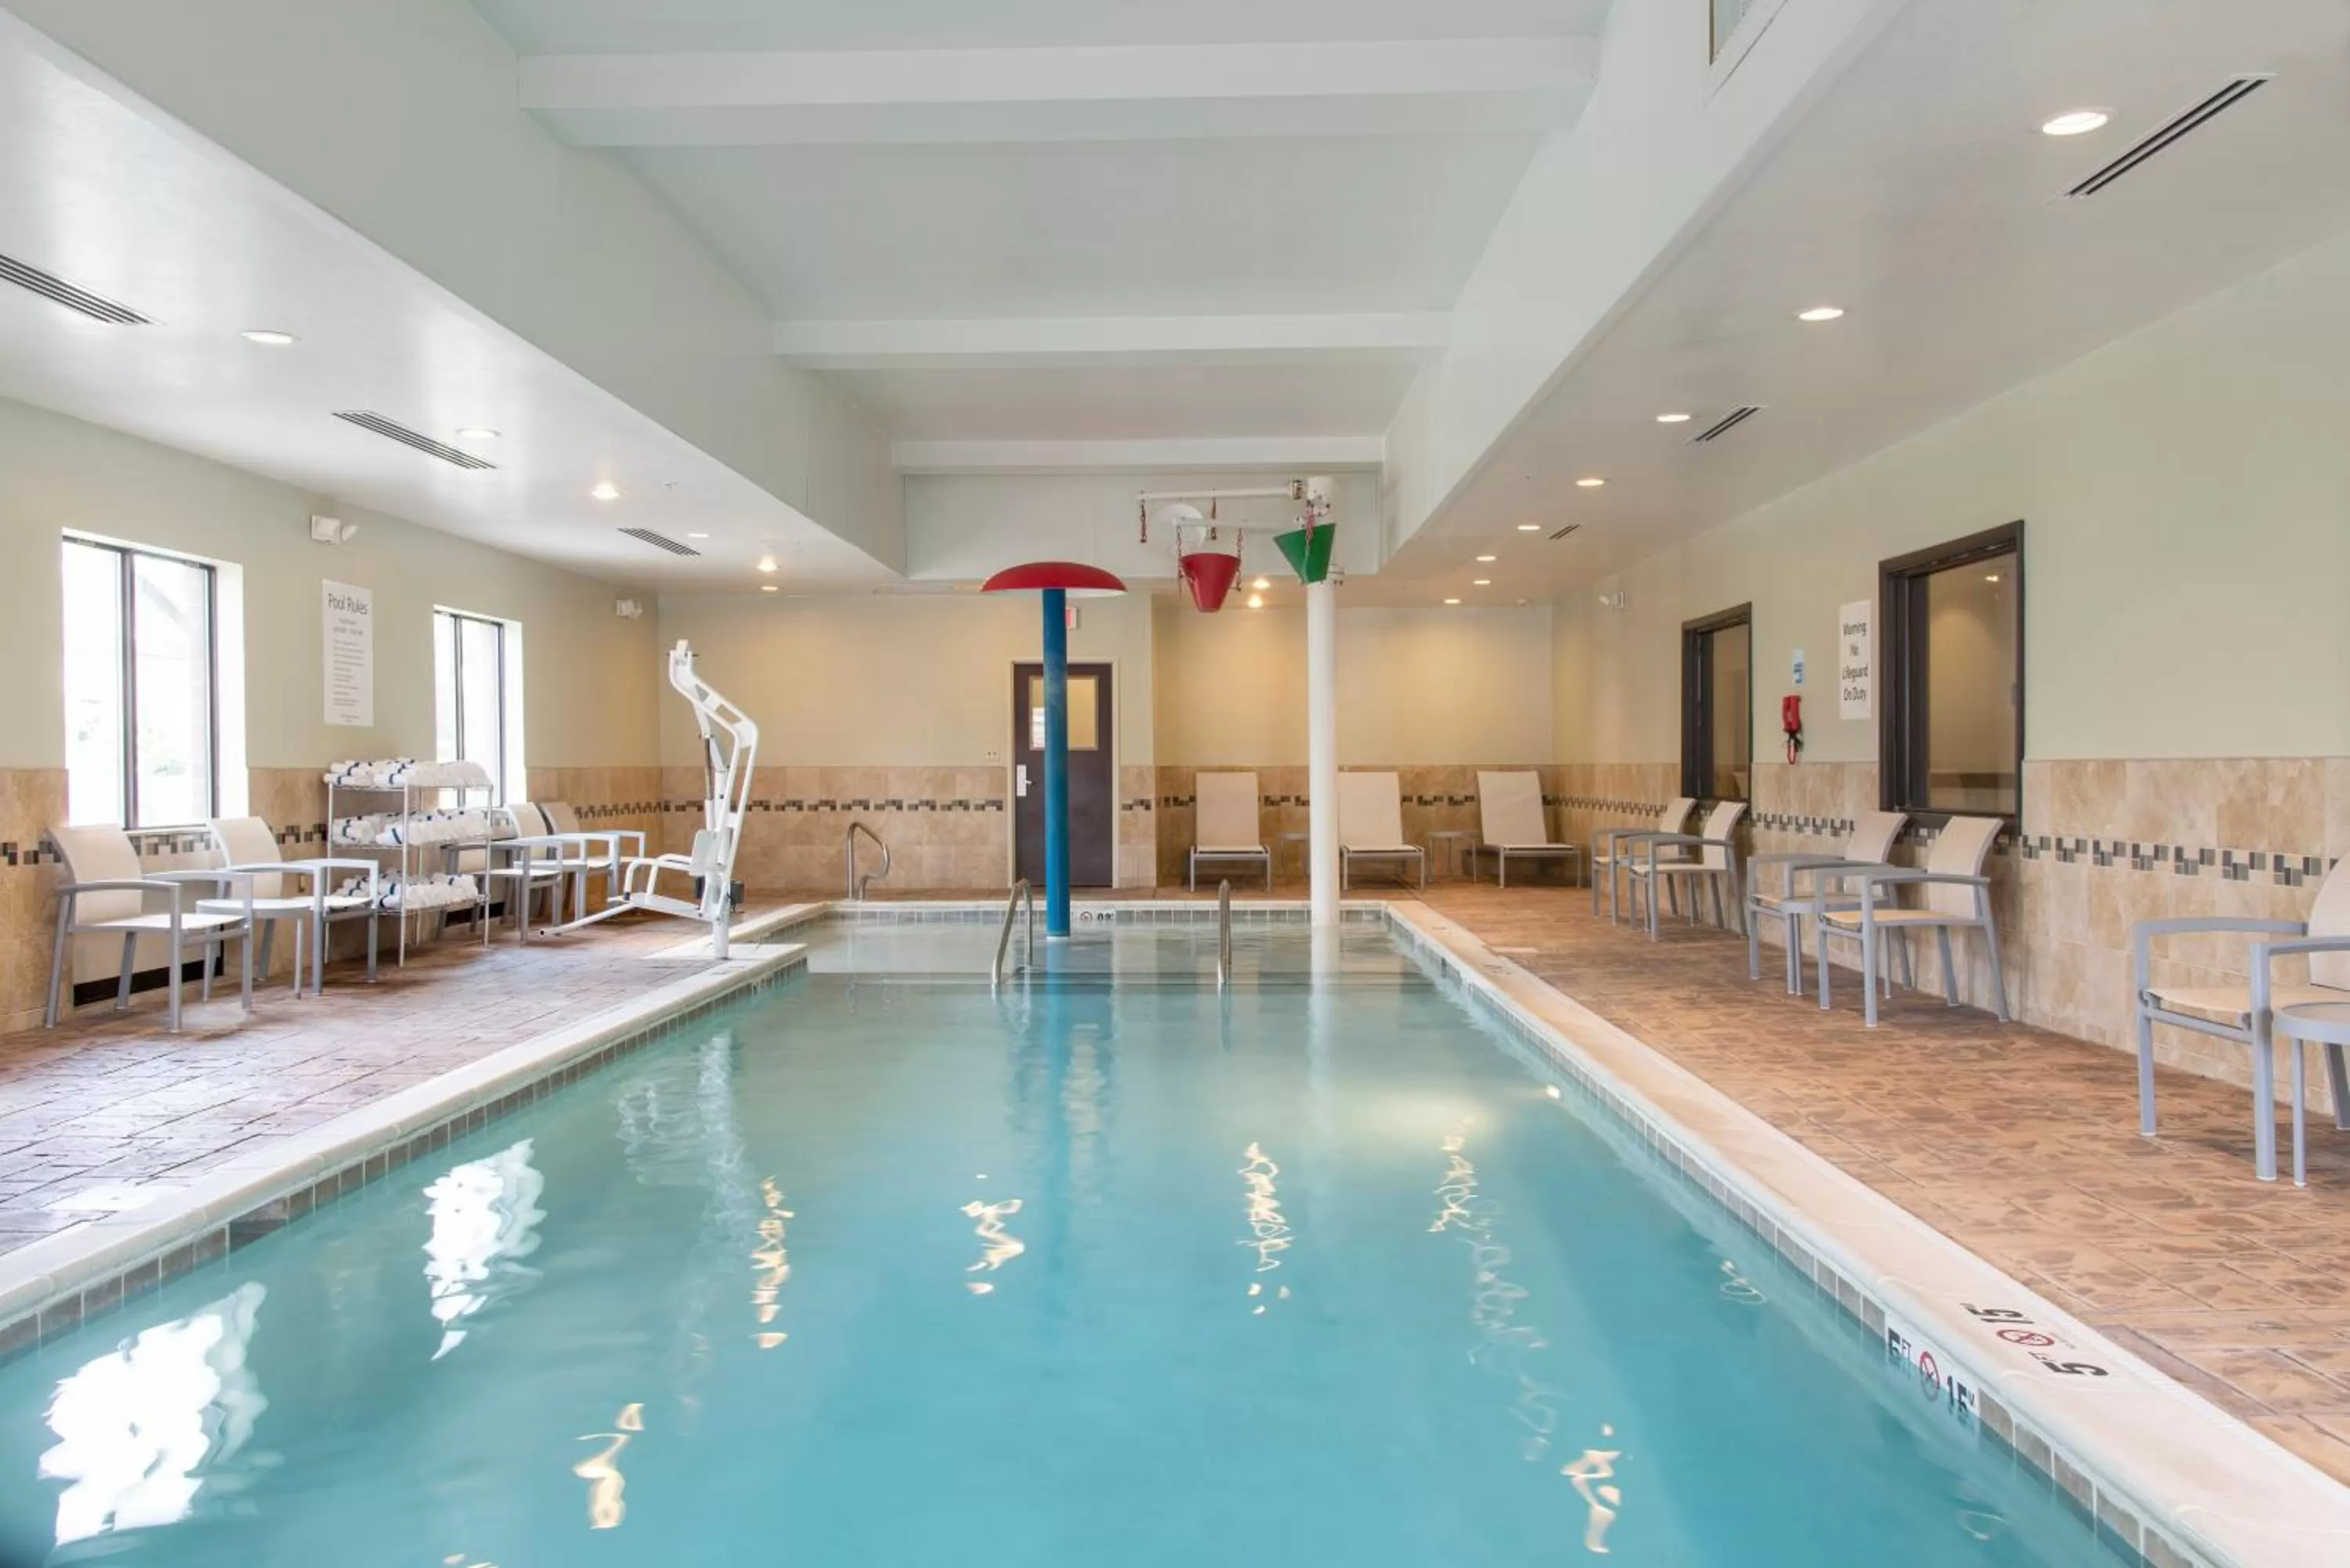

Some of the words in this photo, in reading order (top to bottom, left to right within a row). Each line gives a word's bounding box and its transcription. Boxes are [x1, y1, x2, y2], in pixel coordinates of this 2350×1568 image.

[327, 593, 345, 611] Pool
[347, 597, 369, 615] Rules
[1843, 623, 1867, 637] Warning
[1853, 687, 1867, 702] Duty
